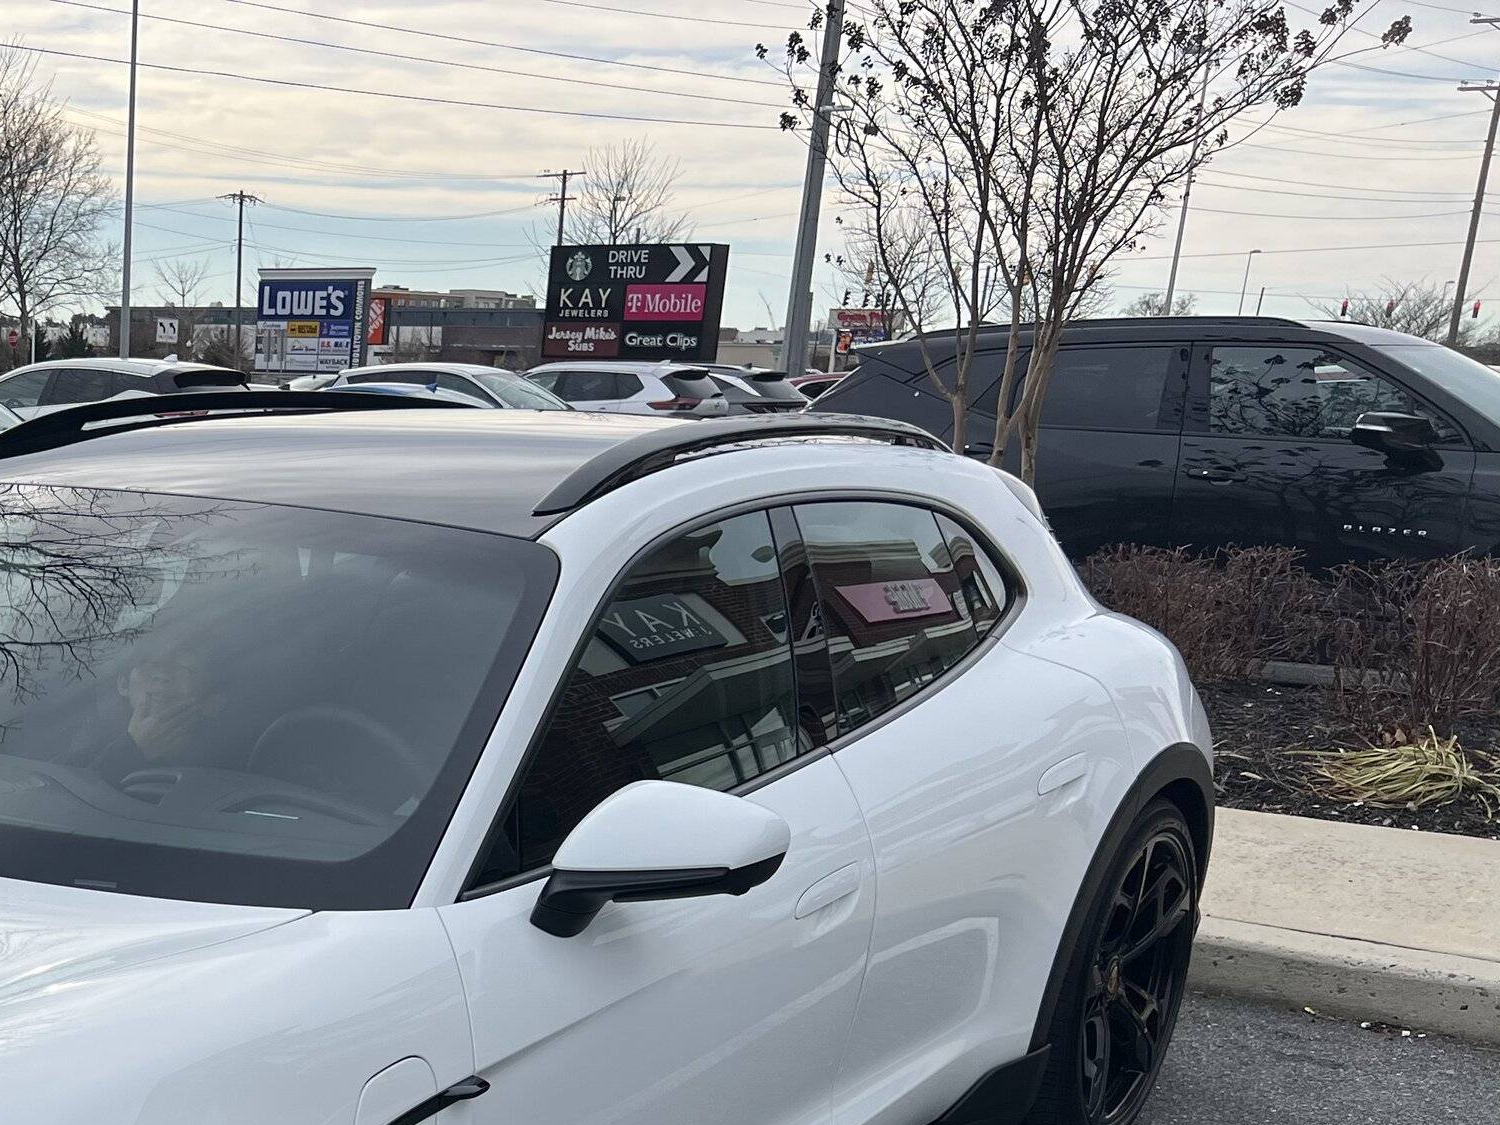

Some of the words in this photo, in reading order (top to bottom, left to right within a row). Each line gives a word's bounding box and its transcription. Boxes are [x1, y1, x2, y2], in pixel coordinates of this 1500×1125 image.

[608, 250, 649, 263] DRIVE
[609, 266, 645, 279] THRU
[559, 288, 611, 308] KAY
[559, 309, 608, 318] JEWELERS
[548, 326, 582, 342] Jersey
[584, 327, 617, 341] Mike's
[625, 333, 662, 347] Great
[667, 333, 697, 351] Clips
[1343, 524, 1427, 537] BLAZER
